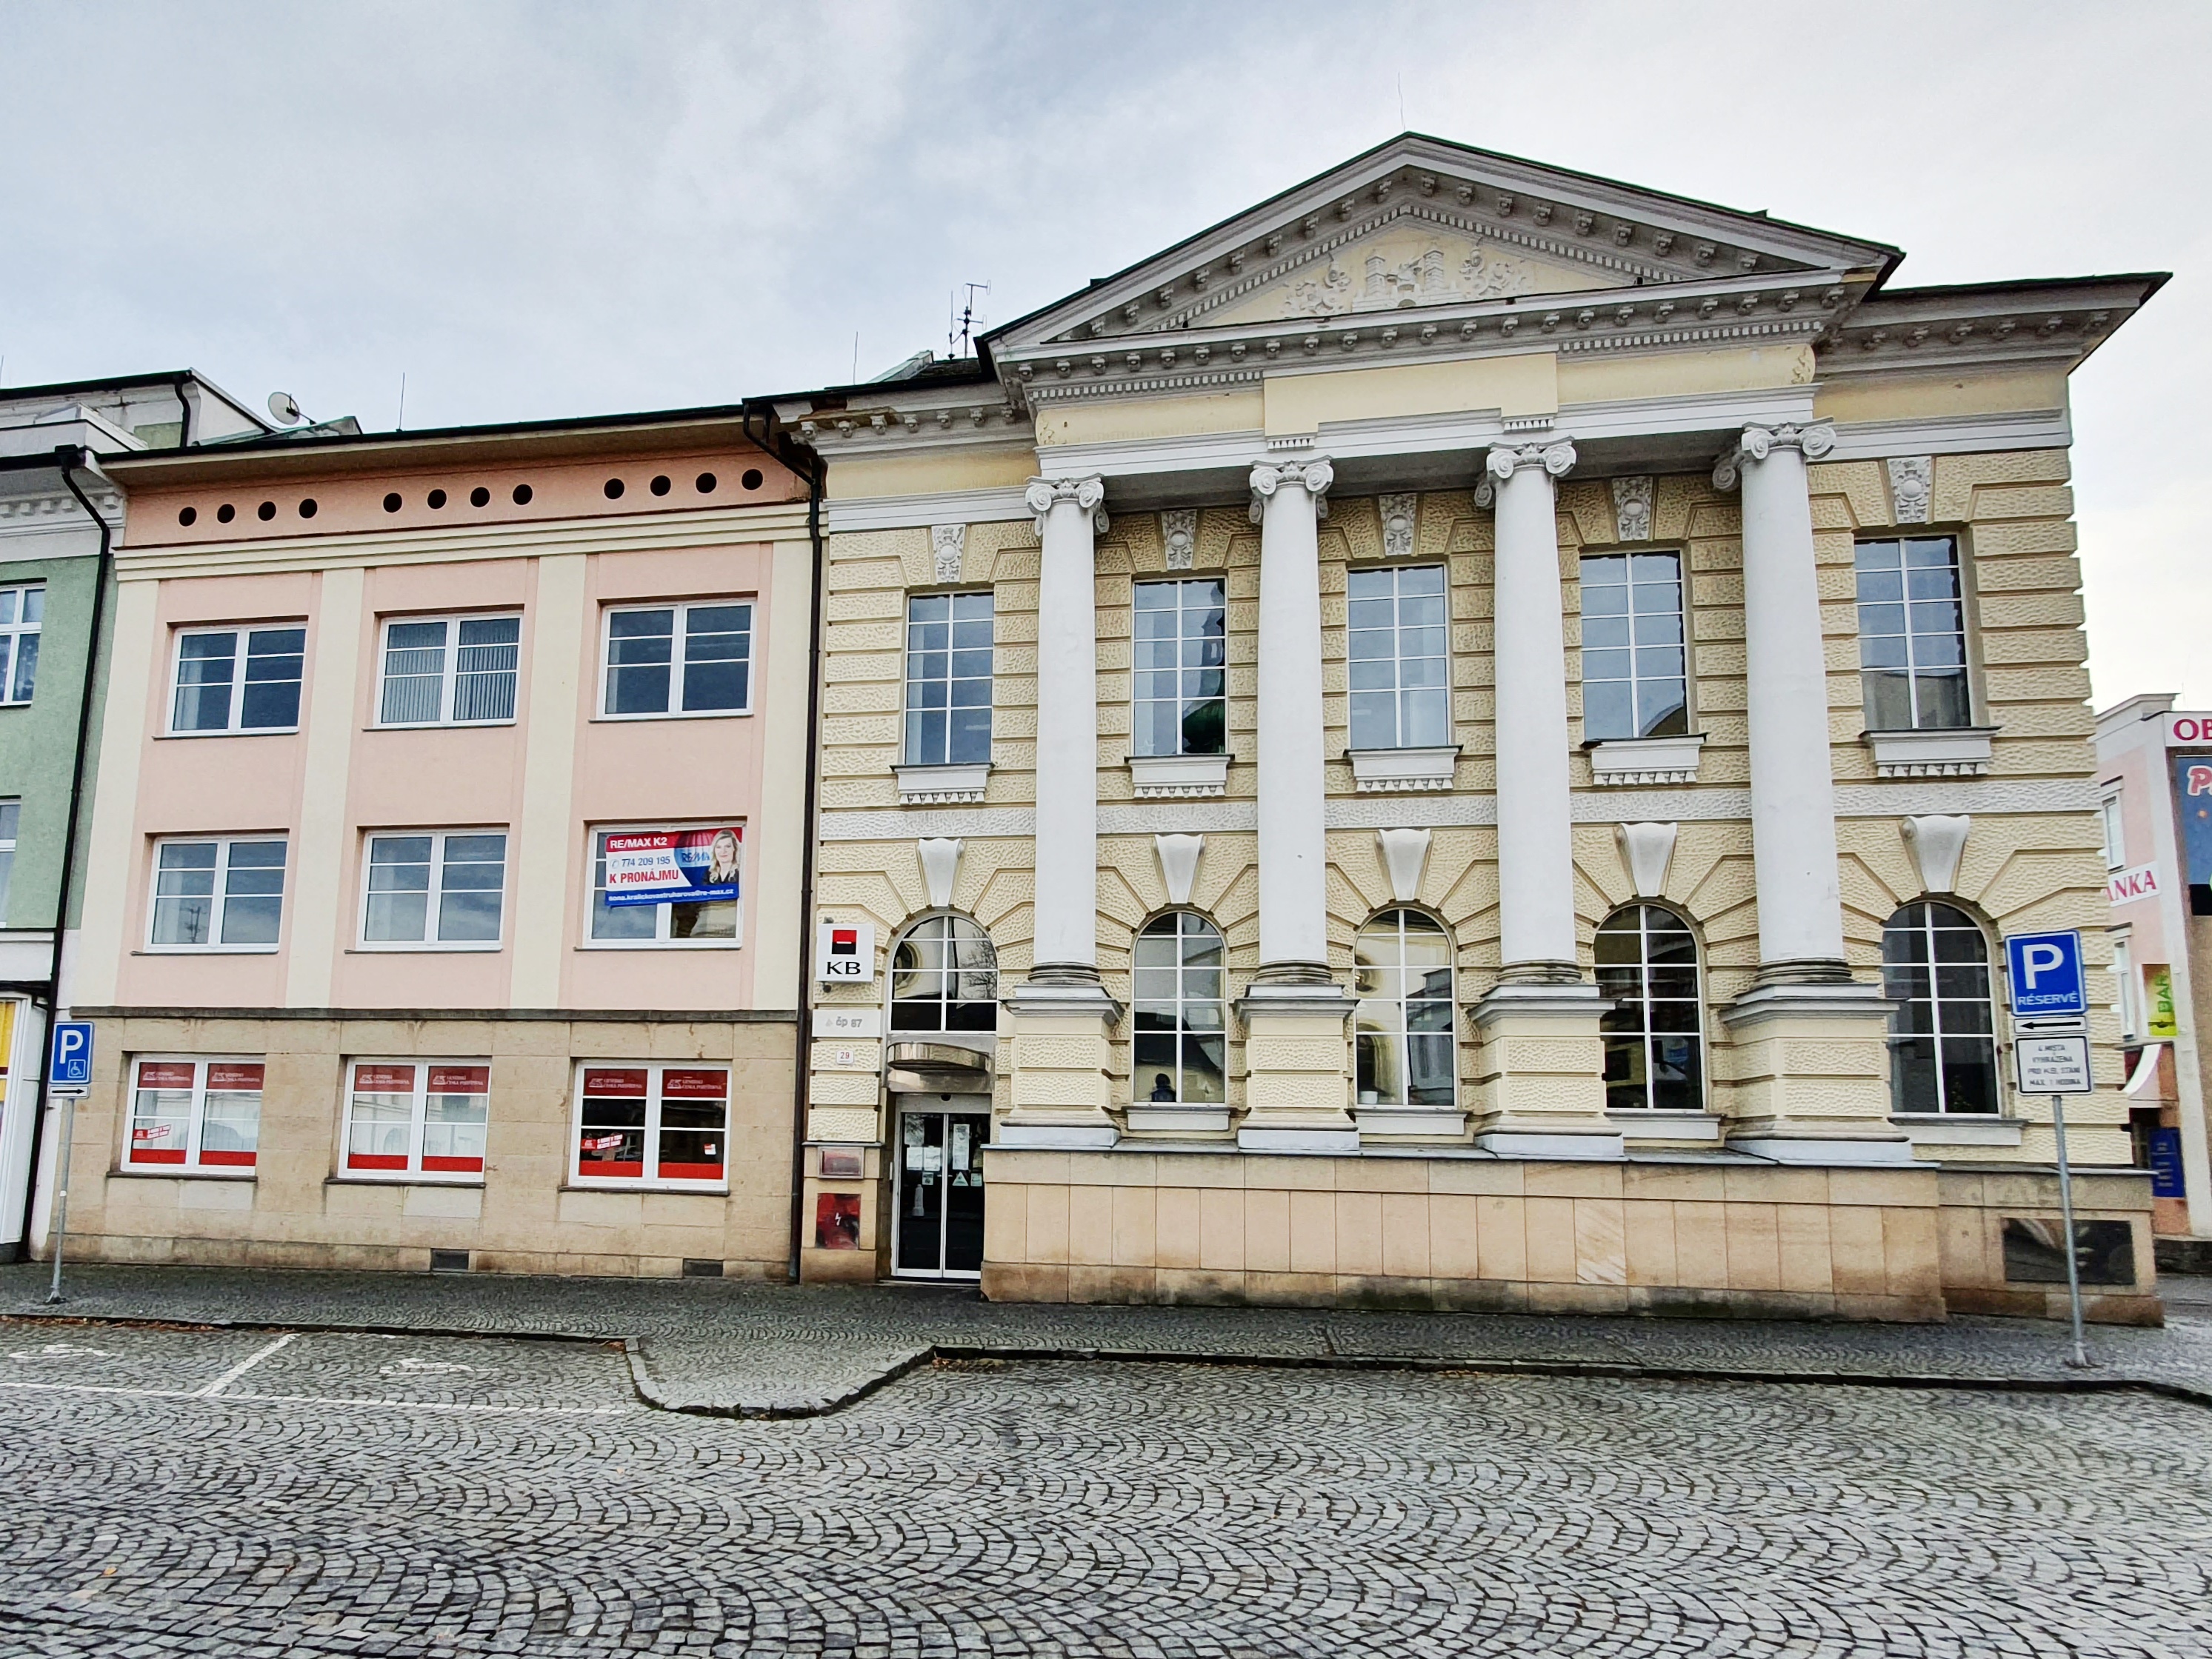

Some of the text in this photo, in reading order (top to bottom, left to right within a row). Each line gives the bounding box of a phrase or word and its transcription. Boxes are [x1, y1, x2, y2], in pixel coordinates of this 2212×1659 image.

[610, 837, 667, 849] RE/MAX K2
[622, 855, 670, 867] 774 209 195
[609, 868, 679, 884] K PRONÁJMU
[827, 961, 861, 975] KB
[2022, 944, 2064, 989] P
[836, 1017, 848, 1028] čp
[59, 1030, 84, 1064] P
